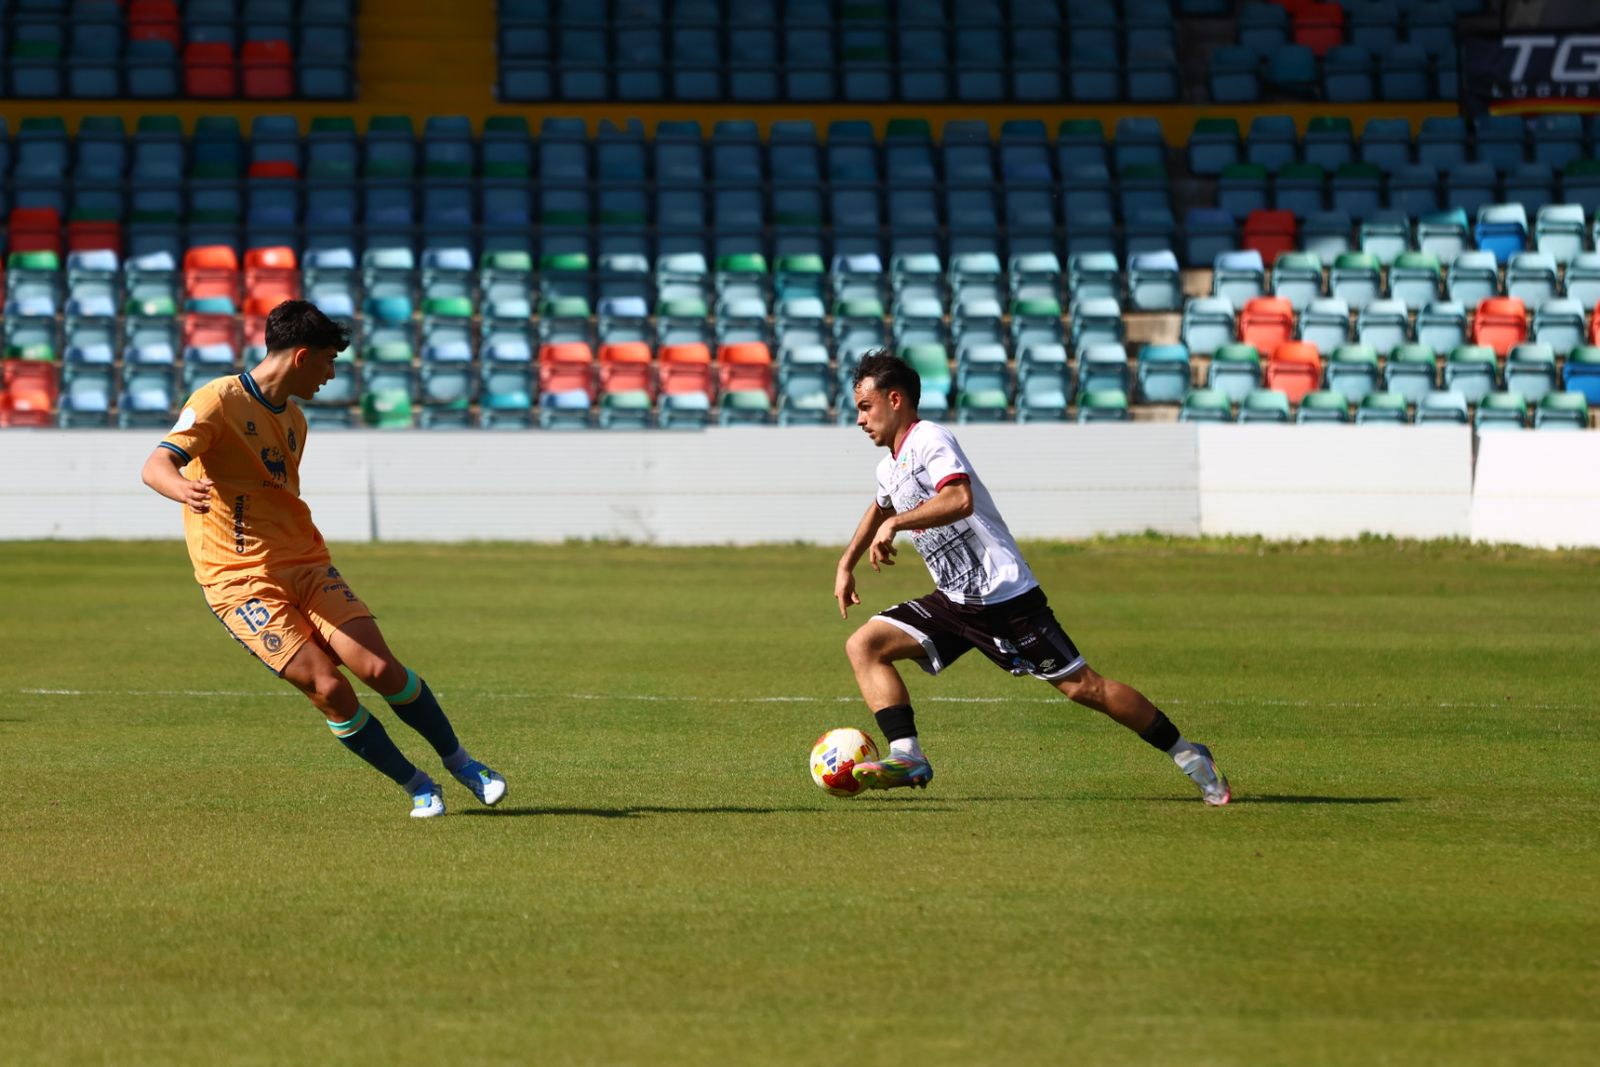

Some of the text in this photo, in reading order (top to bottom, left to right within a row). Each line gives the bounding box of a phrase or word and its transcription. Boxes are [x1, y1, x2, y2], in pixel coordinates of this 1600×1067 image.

[1502, 34, 1600, 82] TG
[1491, 81, 1600, 98] LOGIS
[235, 494, 245, 553] CANTABRIA
[235, 597, 271, 633] 16
